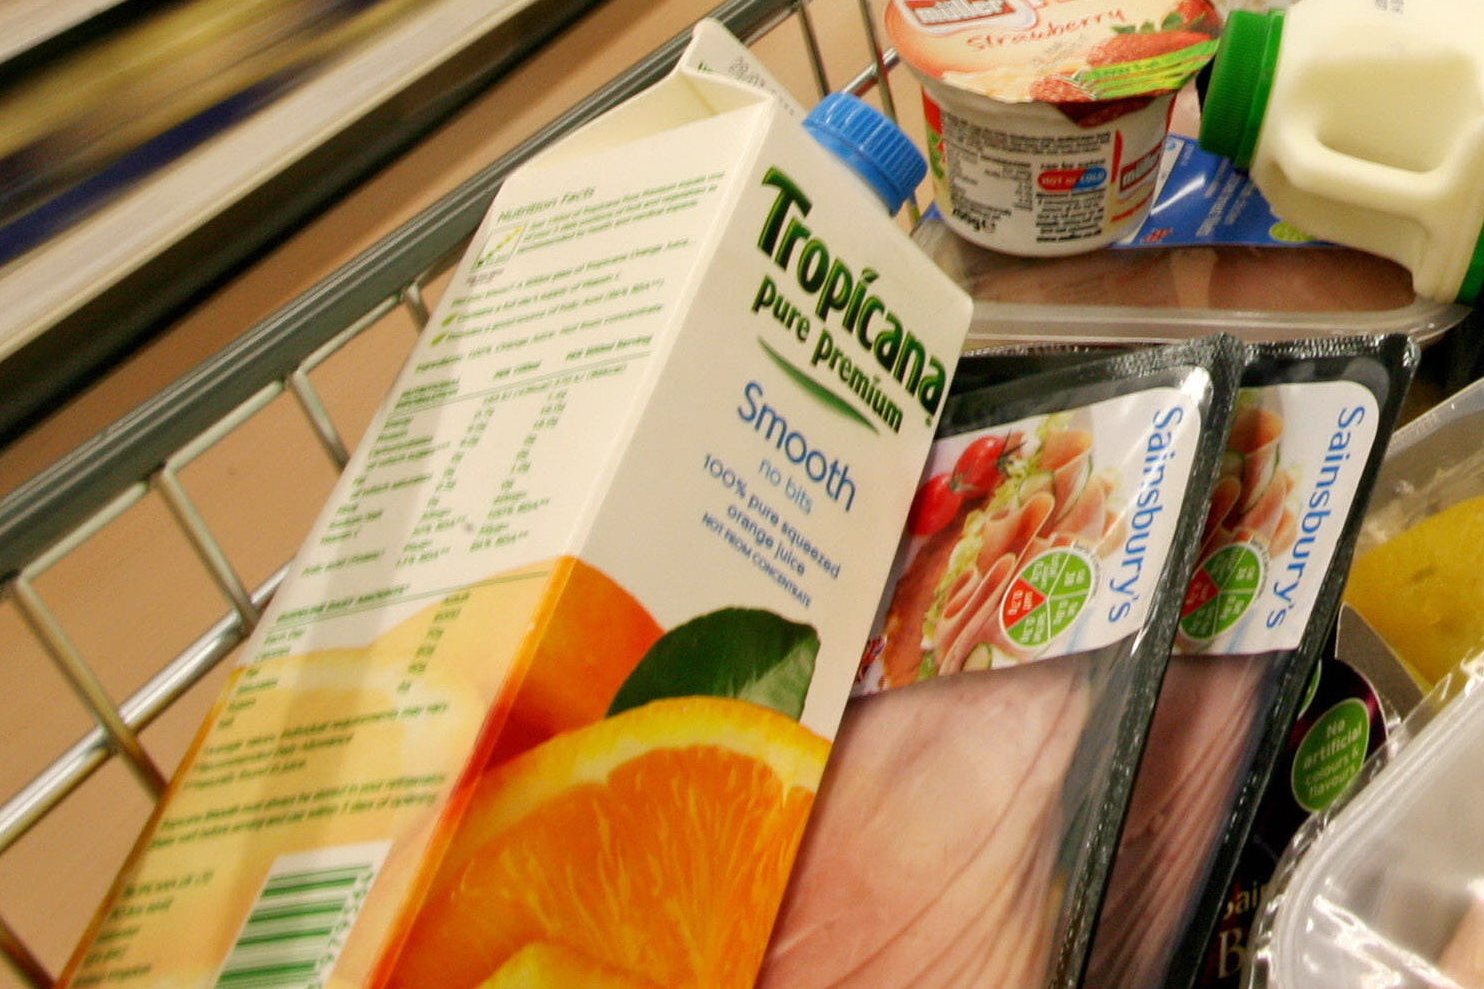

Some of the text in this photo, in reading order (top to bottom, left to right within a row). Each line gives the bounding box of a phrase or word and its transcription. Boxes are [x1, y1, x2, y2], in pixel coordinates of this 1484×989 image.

[965, 8, 1128, 52] Strawberry
[757, 164, 947, 416] Tropicana
[752, 274, 811, 344] pure
[810, 332, 904, 435] premium
[737, 381, 857, 513] Smooth
[758, 458, 813, 516] no bits
[703, 452, 842, 580] 100% pure squeezed
[727, 503, 806, 578] orange juice
[1107, 406, 1183, 625] Sainsbury's
[1265, 405, 1366, 630] Sainsbury's
[724, 528, 752, 559] FROM
[751, 552, 813, 610] CONCENTRATE
[1303, 720, 1363, 769] artificial
[1326, 718, 1346, 740] No
